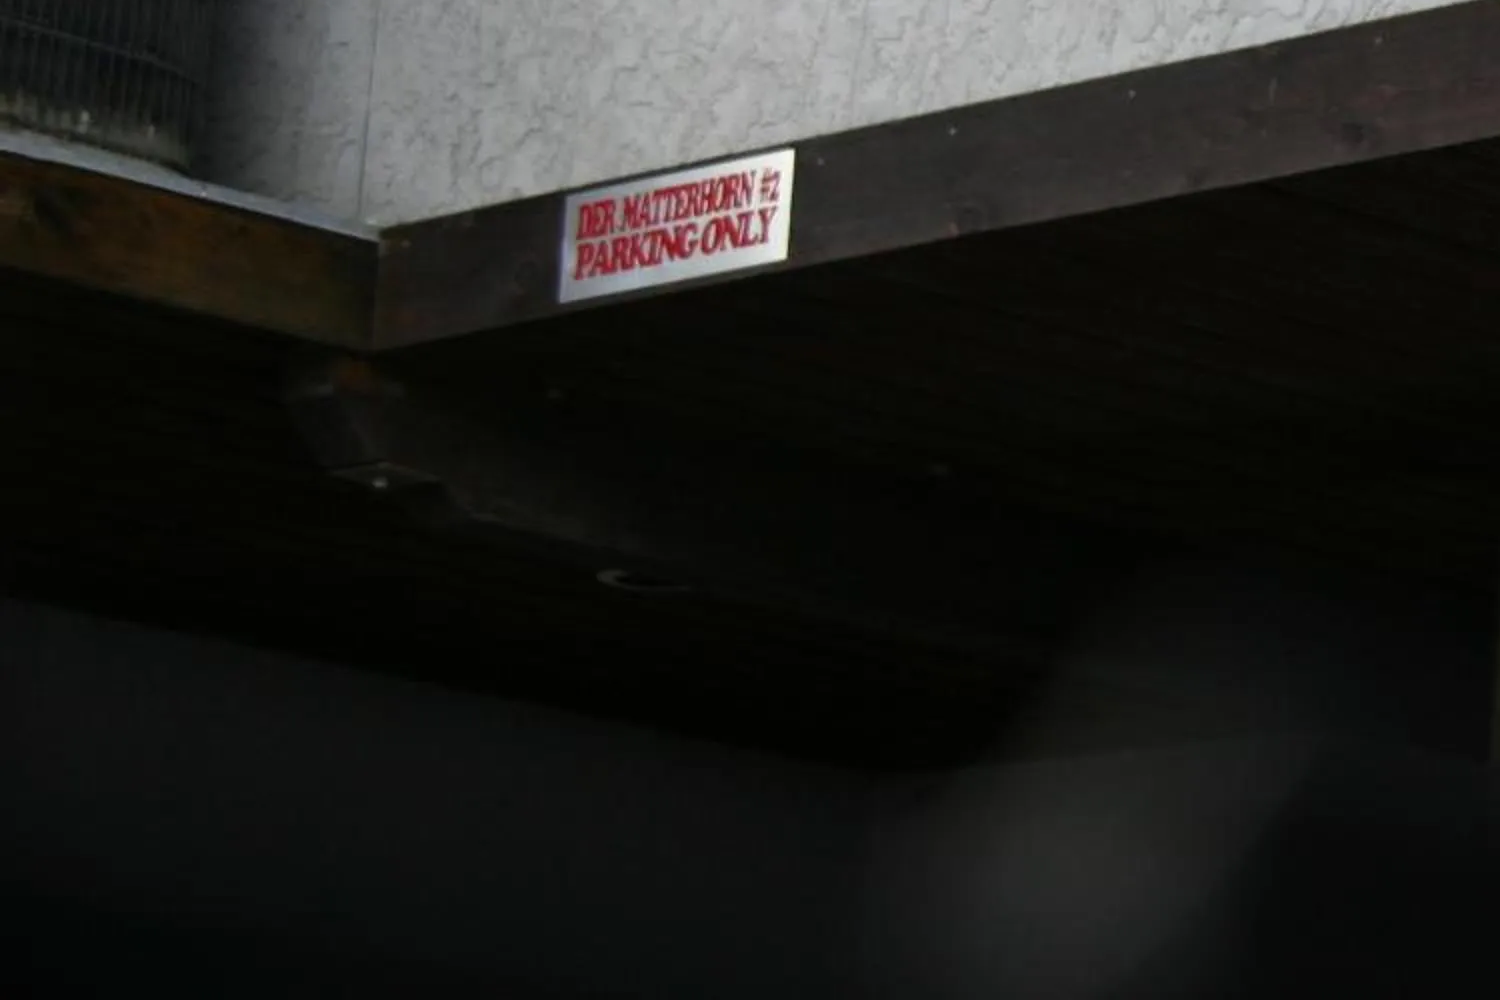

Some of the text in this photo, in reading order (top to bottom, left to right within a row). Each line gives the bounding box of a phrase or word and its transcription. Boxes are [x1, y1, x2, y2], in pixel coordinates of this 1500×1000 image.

[575, 197, 617, 240] DER
[621, 169, 757, 229] MATTERHORN
[574, 205, 778, 281] PARKING ONLY
